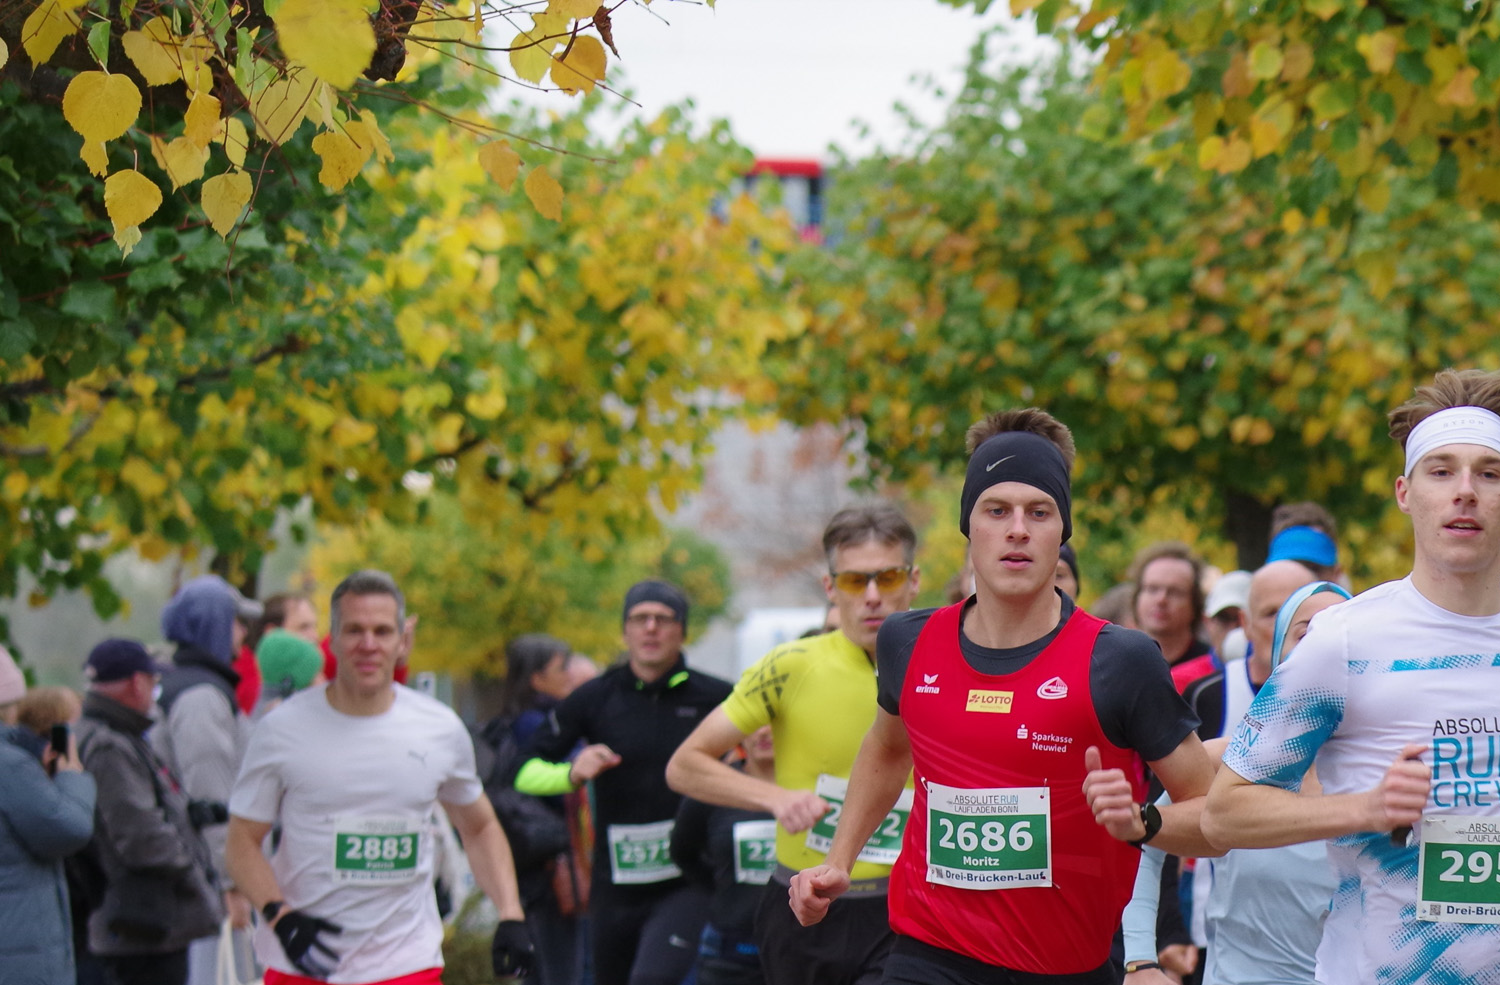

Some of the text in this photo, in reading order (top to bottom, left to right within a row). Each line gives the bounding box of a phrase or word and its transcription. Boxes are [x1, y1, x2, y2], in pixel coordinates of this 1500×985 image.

[915, 684, 940, 694] erima
[982, 695, 1012, 705] LOTTO
[1031, 732, 1073, 744] Sparkasse
[1031, 742, 1067, 753] Neuwied
[954, 805, 1019, 814] LAUFLADEN BONN
[939, 818, 1034, 852] 2686
[345, 836, 412, 860] 2883
[963, 856, 1000, 866] Moritz
[945, 870, 1045, 883] Drei-Brücken-Lauf
